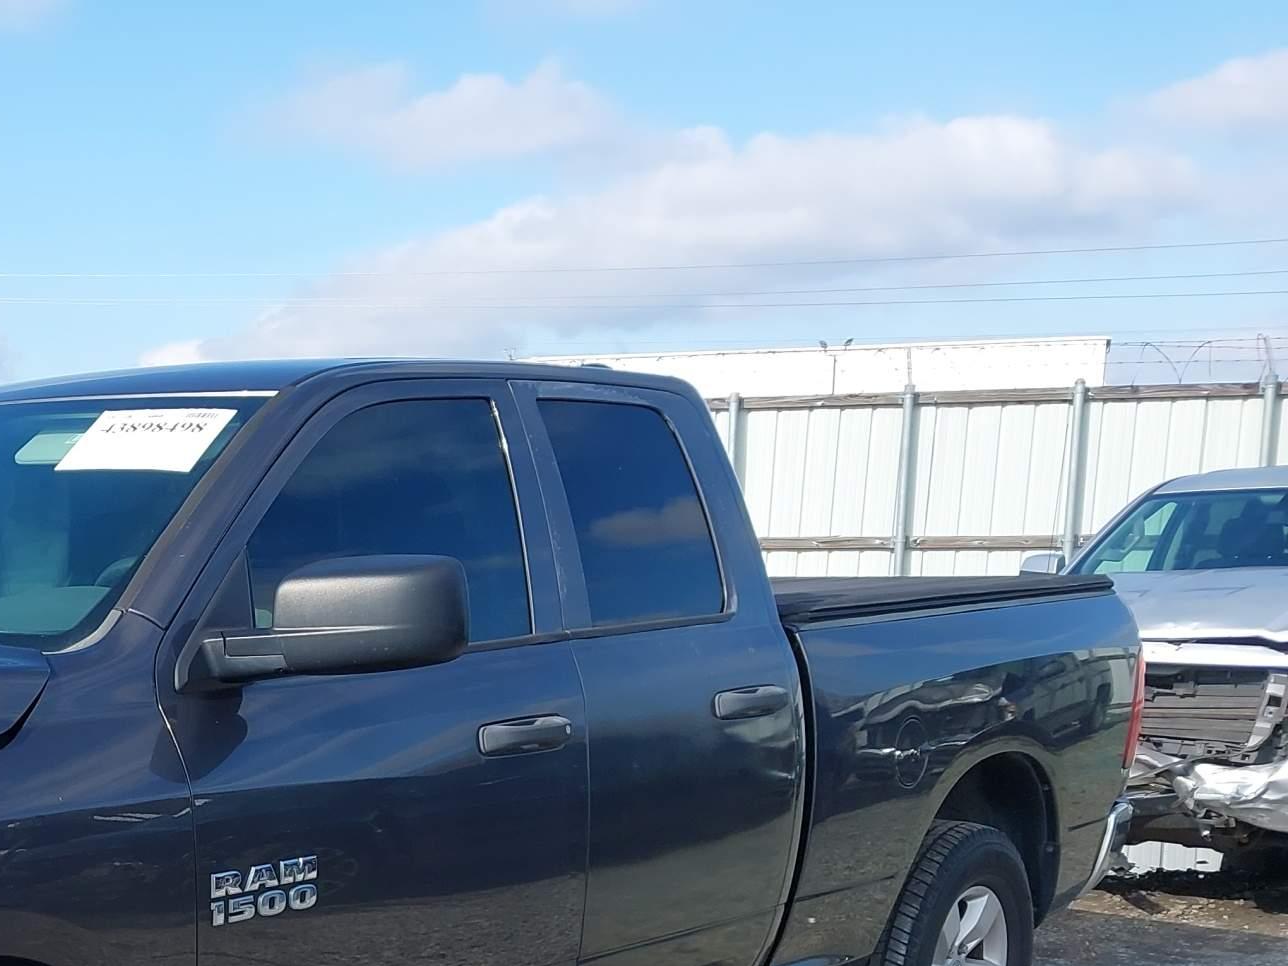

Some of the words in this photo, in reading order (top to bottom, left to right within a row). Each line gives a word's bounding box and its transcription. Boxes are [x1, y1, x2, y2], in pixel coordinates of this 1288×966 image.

[100, 422, 207, 434] 43898498
[211, 855, 318, 899] RAM
[211, 883, 318, 927] 1500
